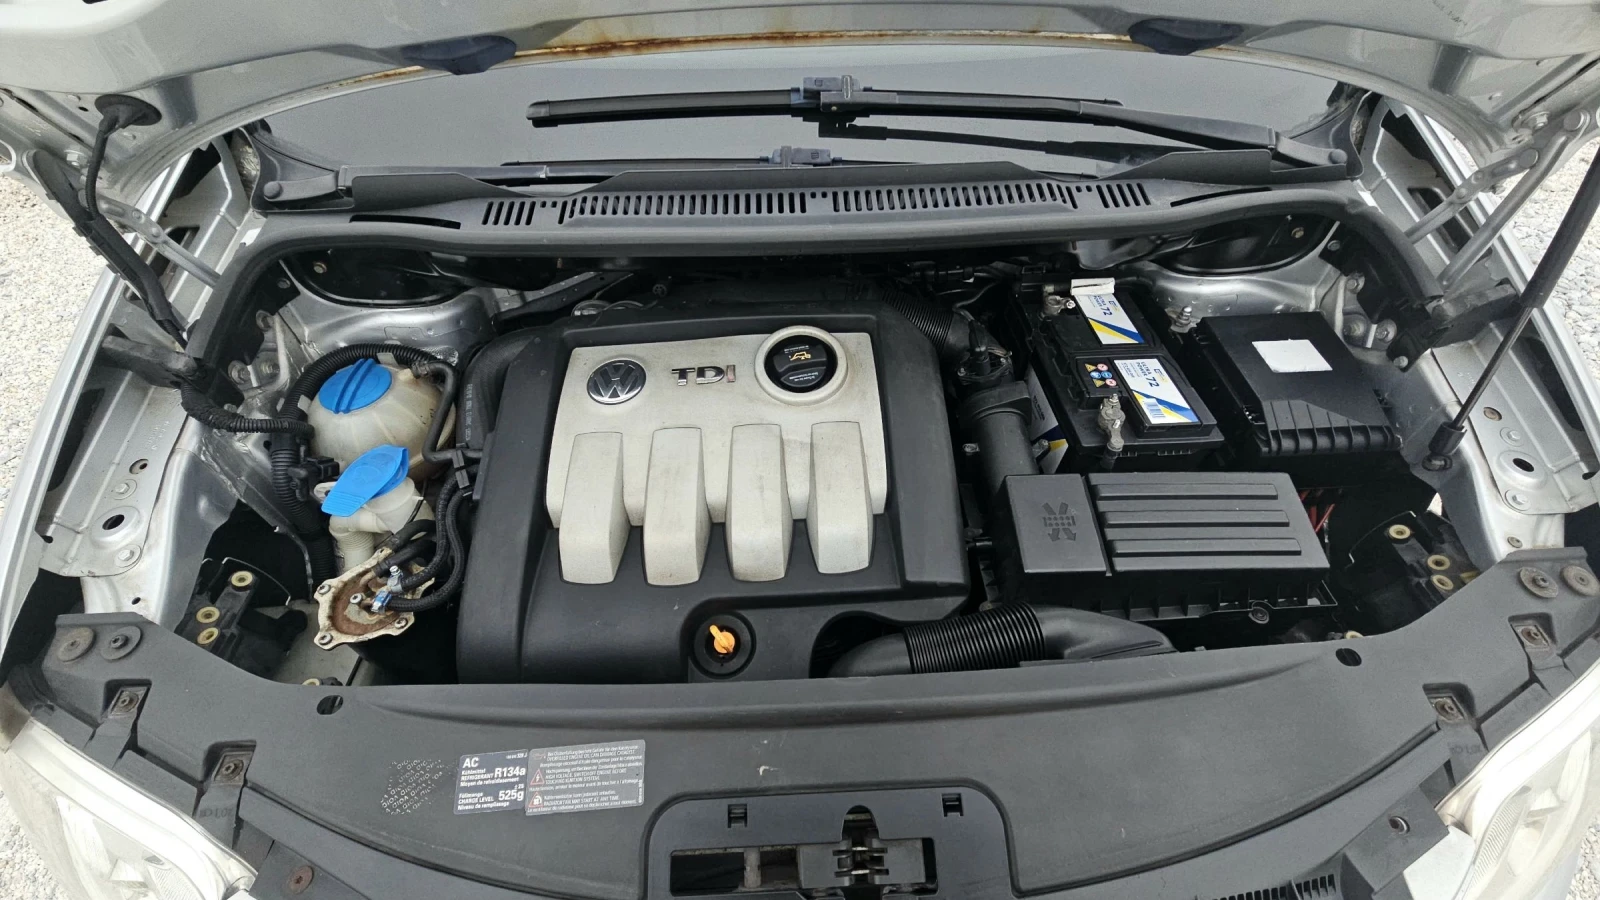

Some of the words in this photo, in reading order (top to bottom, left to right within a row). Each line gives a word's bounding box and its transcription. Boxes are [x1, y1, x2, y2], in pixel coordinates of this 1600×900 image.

[1100, 306, 1113, 316] 72
[671, 364, 736, 386] TDI
[1145, 376, 1160, 388] 72
[462, 756, 480, 769] AC
[494, 765, 526, 778] R134a
[498, 788, 525, 801] 525g
